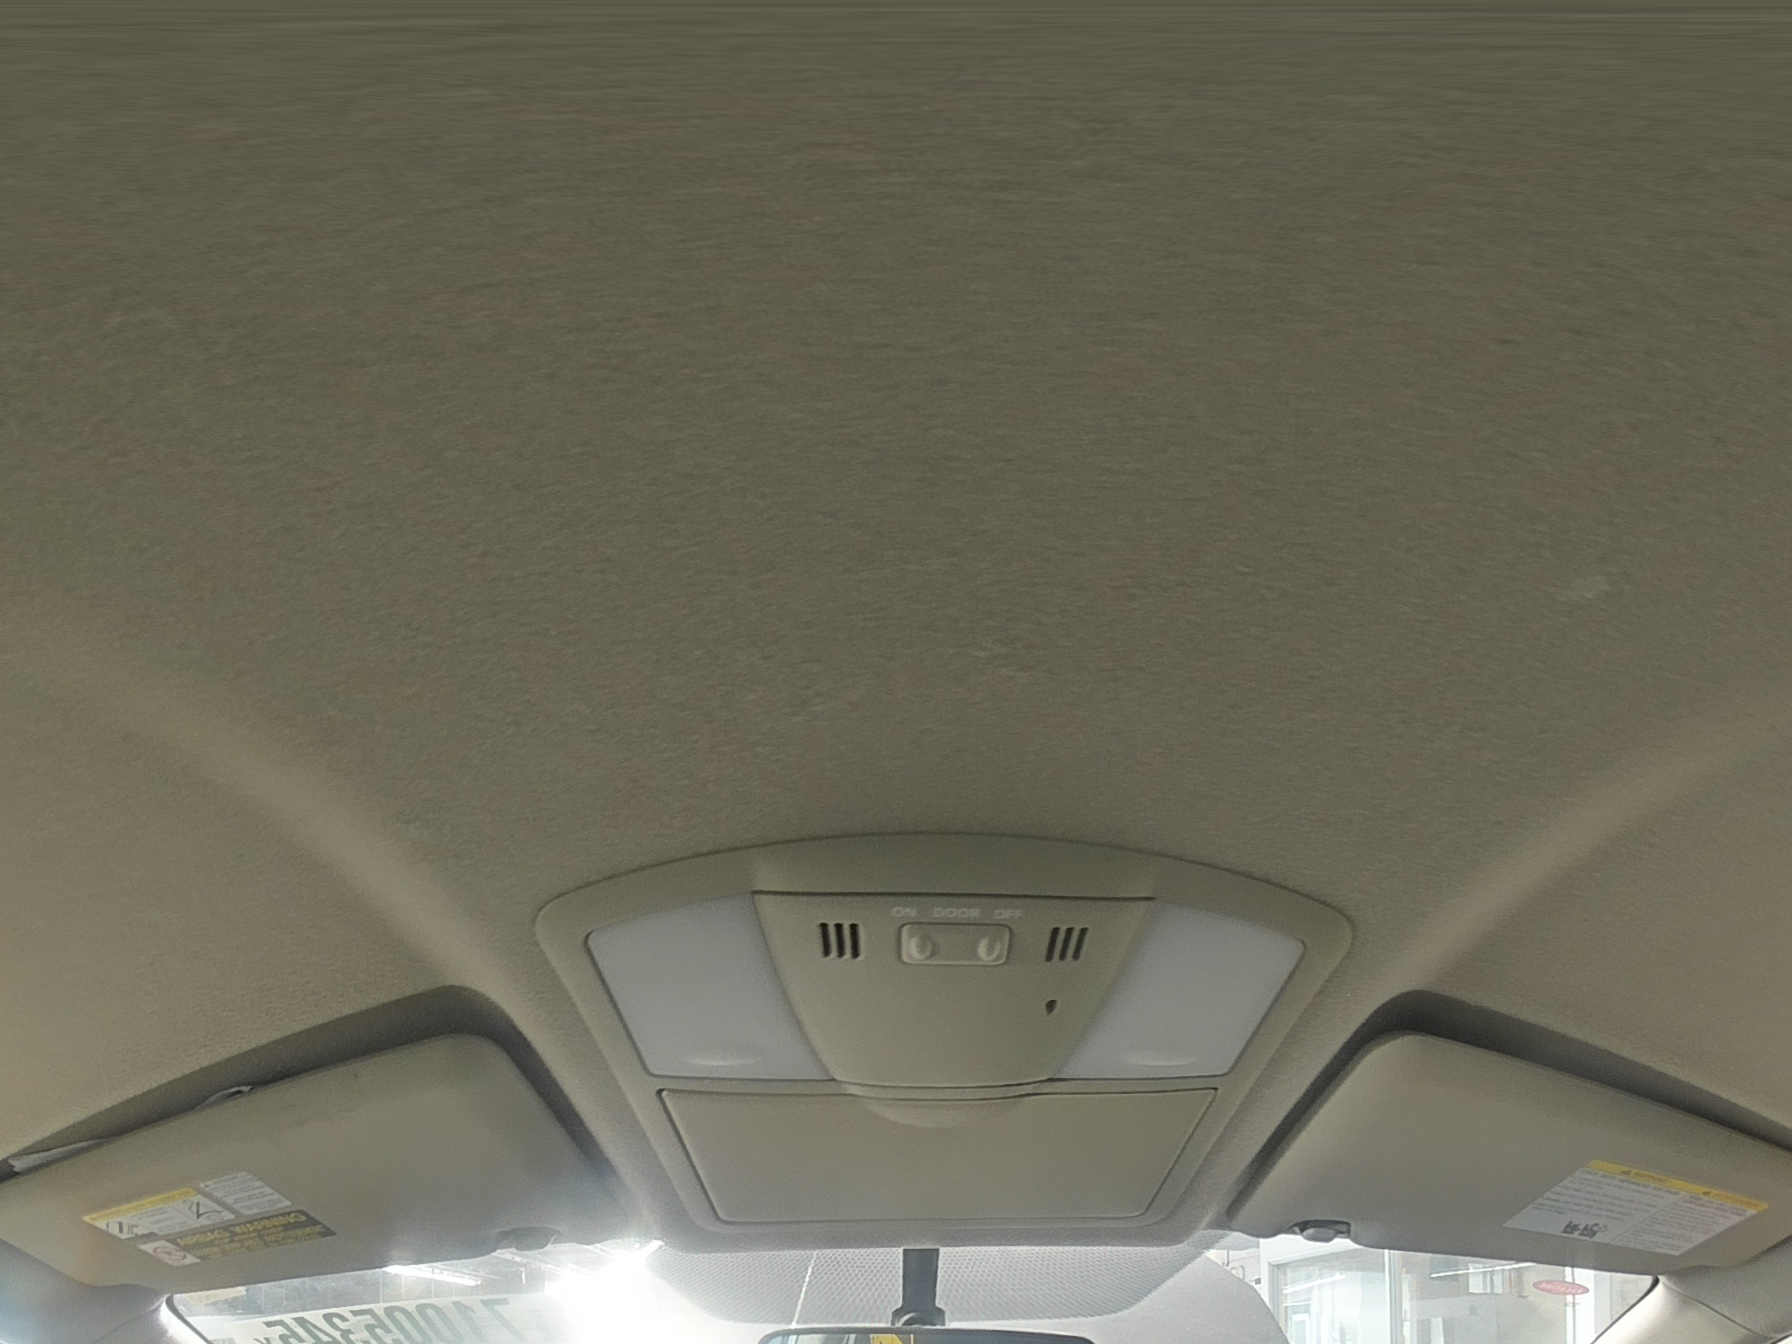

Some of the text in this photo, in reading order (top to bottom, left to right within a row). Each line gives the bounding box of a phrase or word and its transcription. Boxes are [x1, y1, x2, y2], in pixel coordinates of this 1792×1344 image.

[891, 906, 917, 918] ON
[933, 907, 982, 918] DOOR
[993, 908, 1024, 919] OFF
[230, 1208, 308, 1235] WARNING
